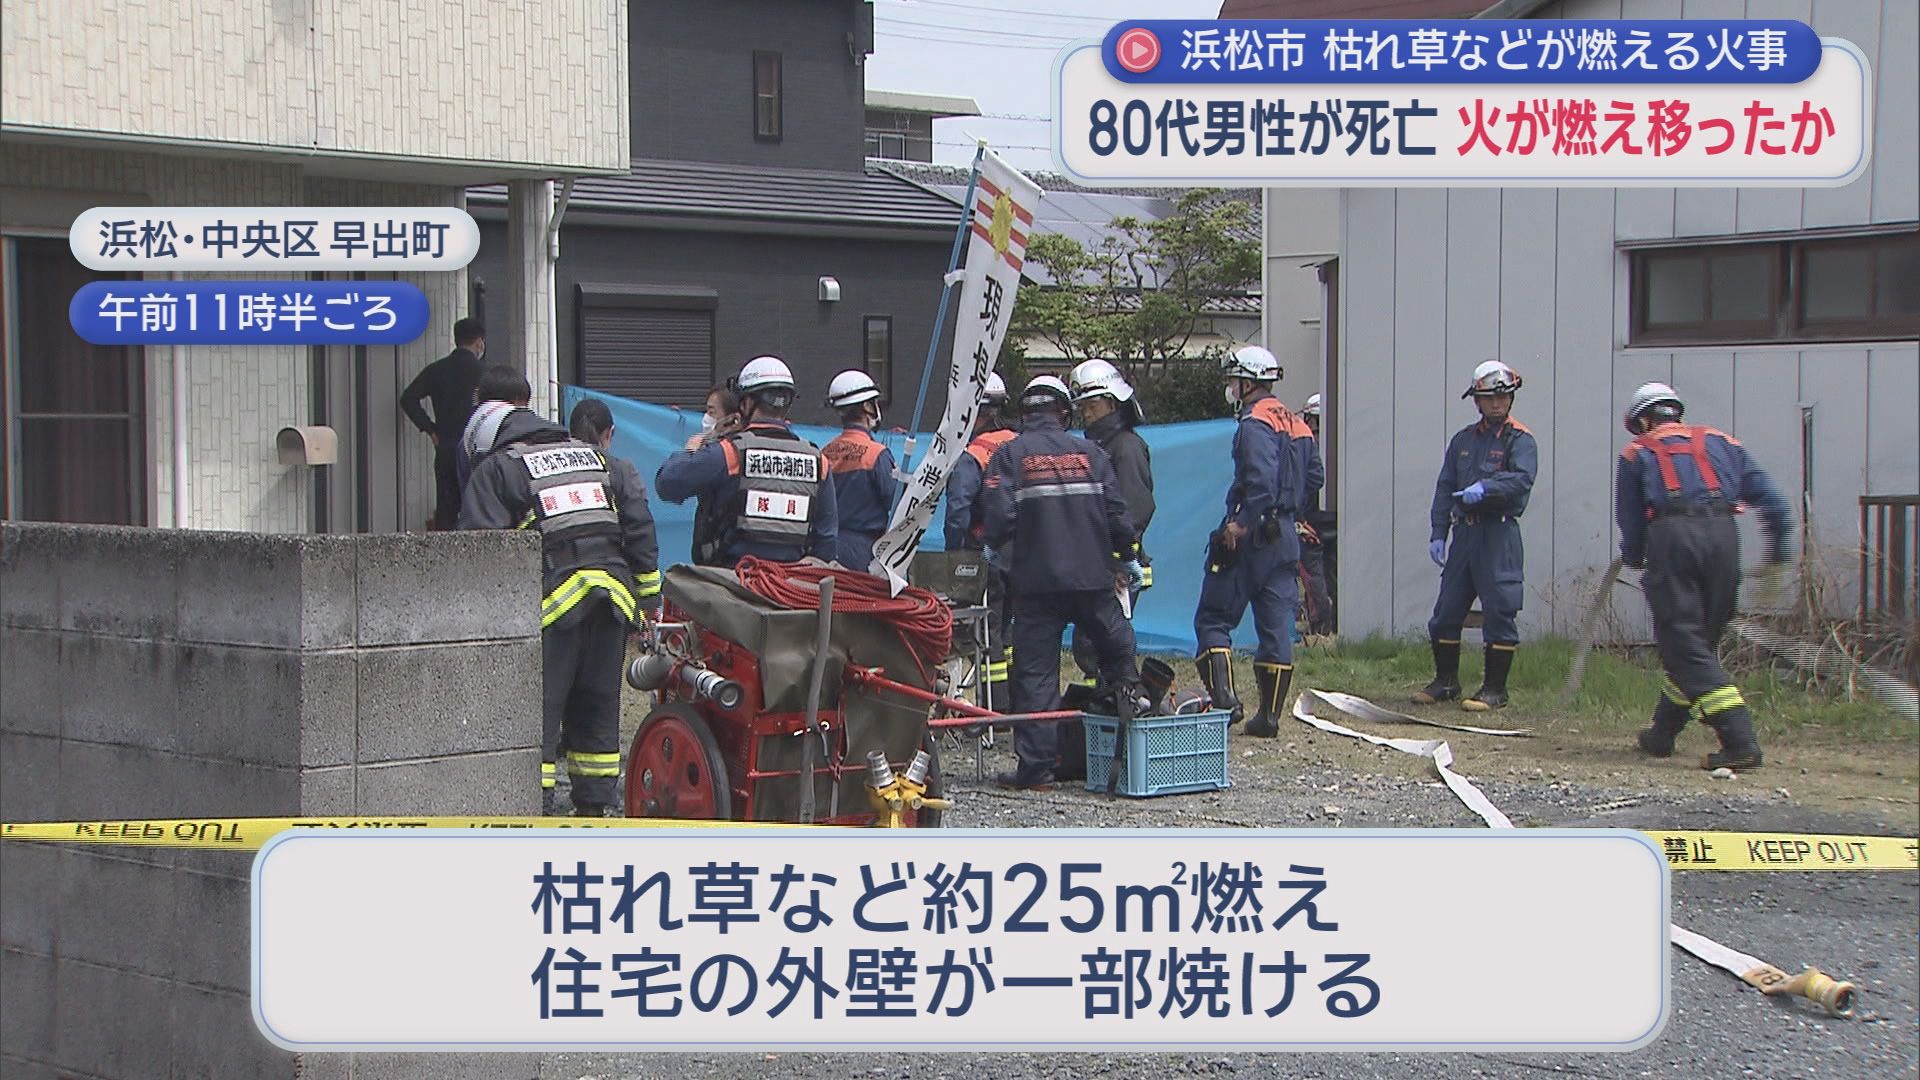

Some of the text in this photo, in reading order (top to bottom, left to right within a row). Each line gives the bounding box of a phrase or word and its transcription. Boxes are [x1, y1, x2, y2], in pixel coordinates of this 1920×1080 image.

[747, 453, 815, 479] 浜松市消防局
[1663, 836, 1717, 864] 禁止
[1746, 839, 1868, 864] KEEP OUT
